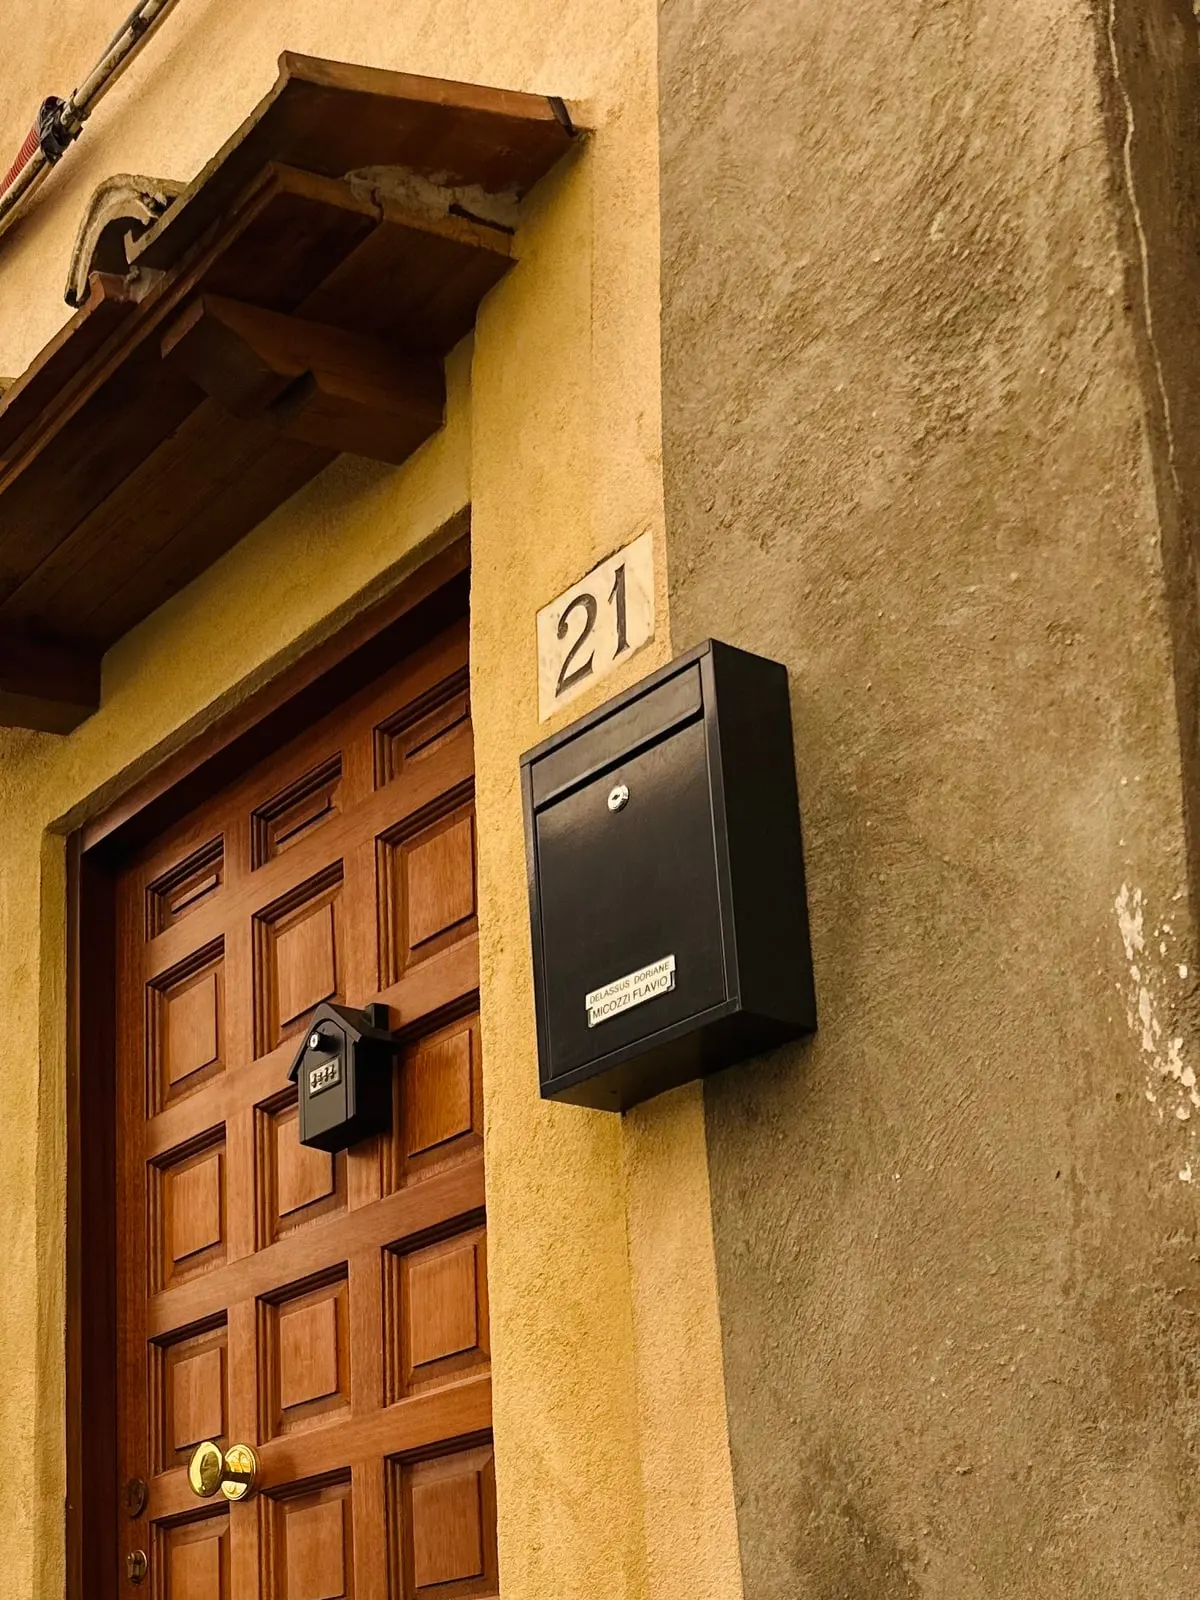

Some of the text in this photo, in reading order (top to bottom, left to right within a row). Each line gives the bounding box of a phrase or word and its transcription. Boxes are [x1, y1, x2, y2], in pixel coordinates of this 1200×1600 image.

[555, 563, 630, 698] 21
[589, 961, 670, 1004] DELASSUS DORIANE
[592, 975, 668, 1019] MICOZZI FLAVIO
